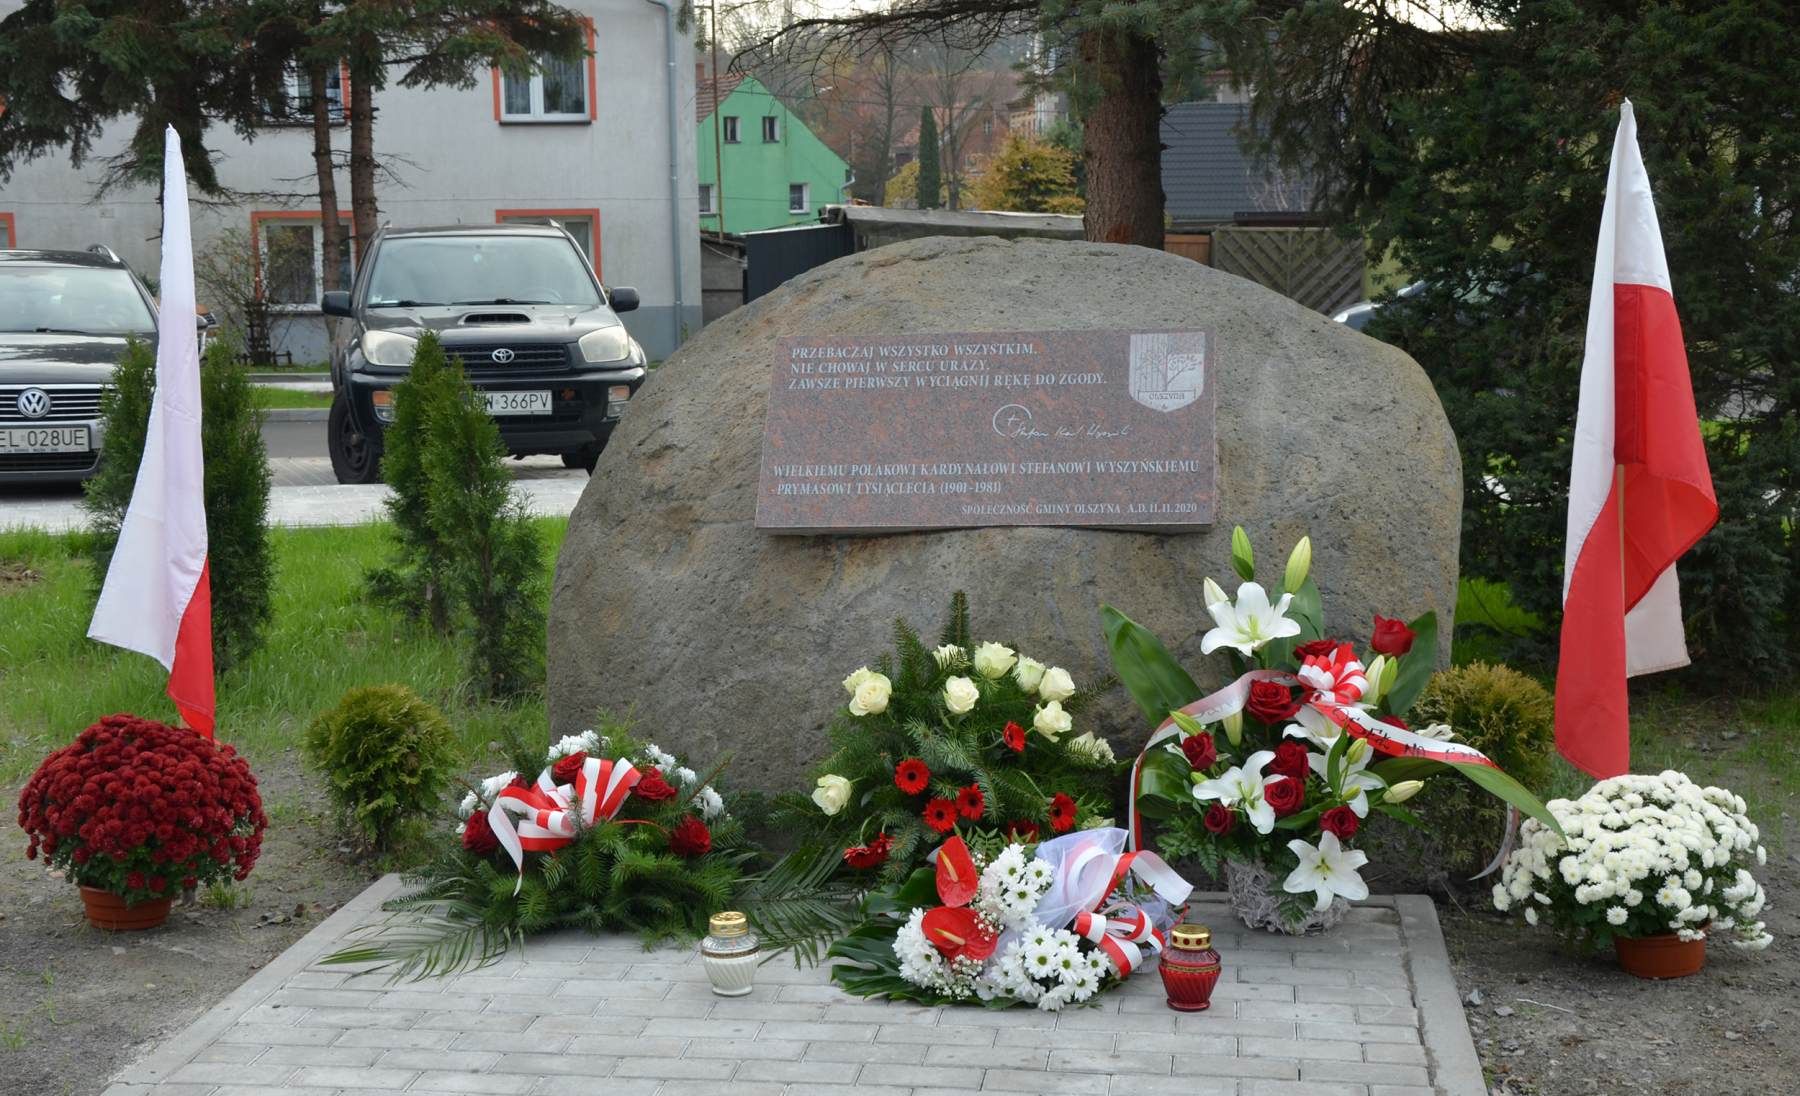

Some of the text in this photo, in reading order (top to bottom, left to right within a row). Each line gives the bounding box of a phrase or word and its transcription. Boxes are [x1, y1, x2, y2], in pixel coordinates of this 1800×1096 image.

[792, 343, 1037, 359] PRZEBACZAJ WSZYSTKO WSZYSTKIM.
[791, 362, 815, 374] NIE
[819, 361, 870, 374] CHOWAJ
[876, 361, 887, 372] W
[893, 360, 935, 372] SERCU
[788, 372, 1108, 390] ZAWSZE PIERWSZY WYCIĄGNIJ RĘKĘ DO ZGODY.
[500, 393, 549, 409] 366PV
[27, 429, 85, 447] 028UE
[774, 458, 1199, 477] WIELKIEMU POLAKOWI KARDYNAŁOWI STEFANOWI WYSZYŃSKIEMU
[777, 482, 852, 496] PRYMASOWI
[856, 481, 936, 497] TYSIĄCLECIA
[1035, 503, 1072, 514] GMINY
[1074, 503, 1121, 513] OLSZYNA
